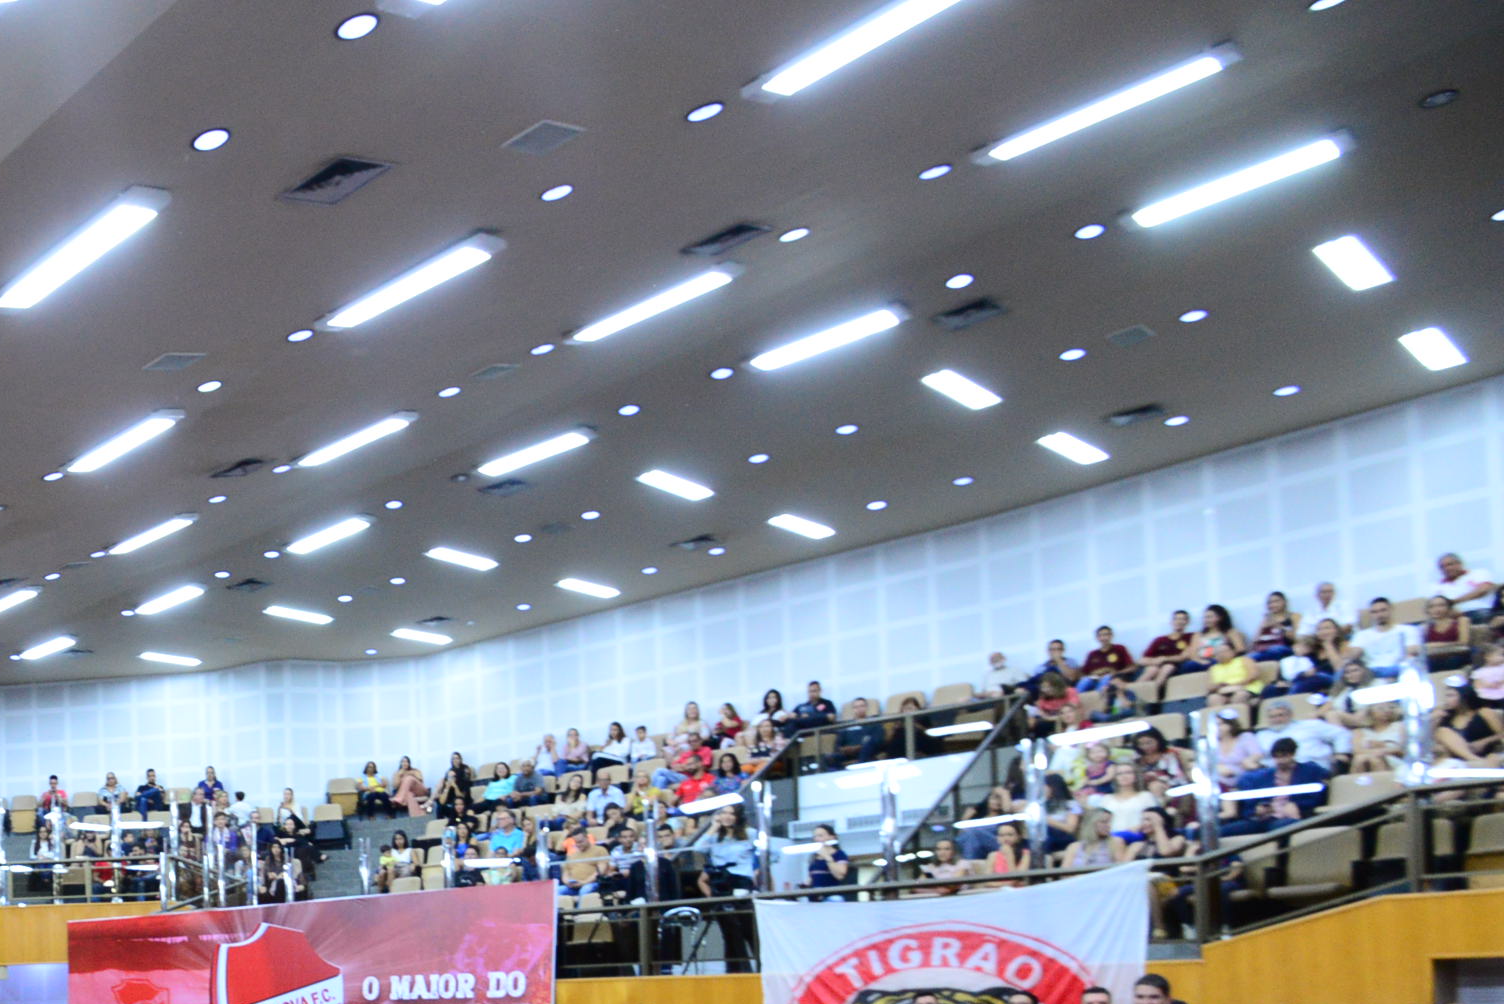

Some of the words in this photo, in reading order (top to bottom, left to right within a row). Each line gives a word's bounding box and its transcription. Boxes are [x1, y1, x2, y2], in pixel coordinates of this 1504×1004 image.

[834, 935, 1043, 989] TIGRÃO
[362, 975, 380, 1001] O
[389, 972, 476, 1000] MAIOR
[486, 970, 527, 998] DO
